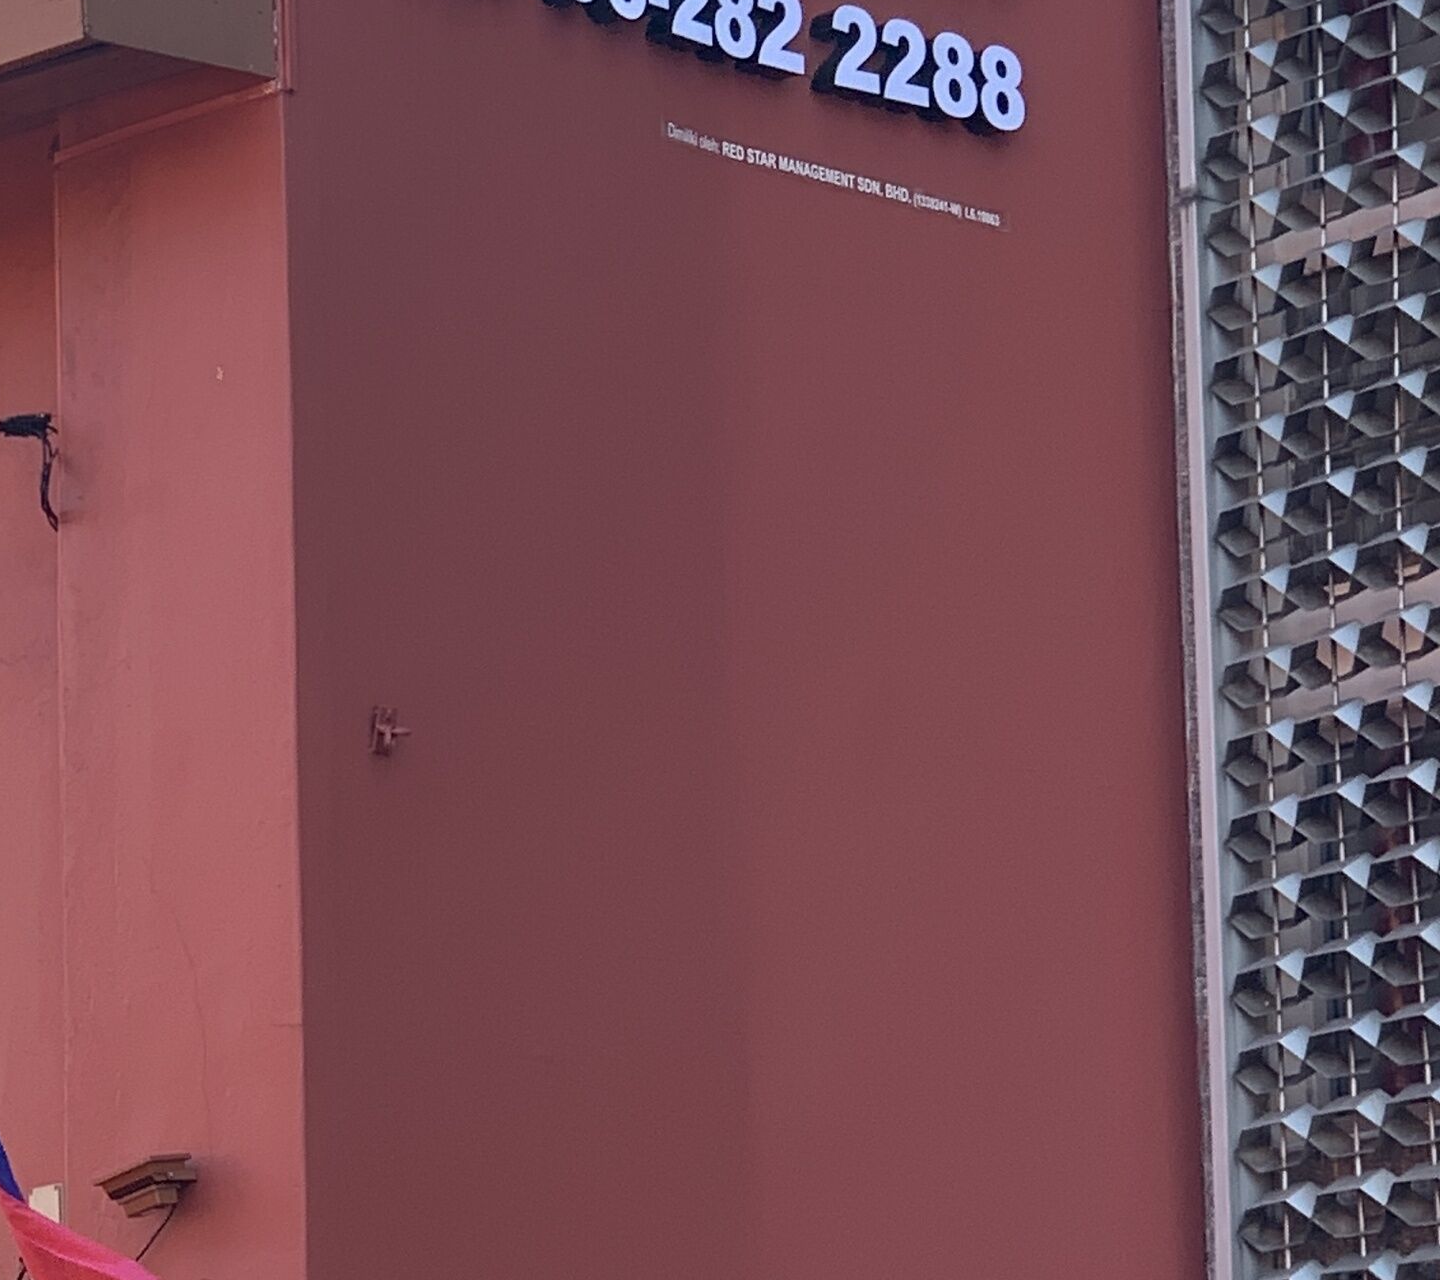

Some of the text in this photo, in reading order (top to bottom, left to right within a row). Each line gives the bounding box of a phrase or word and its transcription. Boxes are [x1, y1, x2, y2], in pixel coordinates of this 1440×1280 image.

[831, 4, 1026, 131] 2288
[722, 141, 745, 161] RED
[746, 148, 777, 170] STAR
[778, 154, 856, 191] MANAGEMENT
[857, 175, 884, 196] SDN.
[885, 182, 912, 205] BHD.
